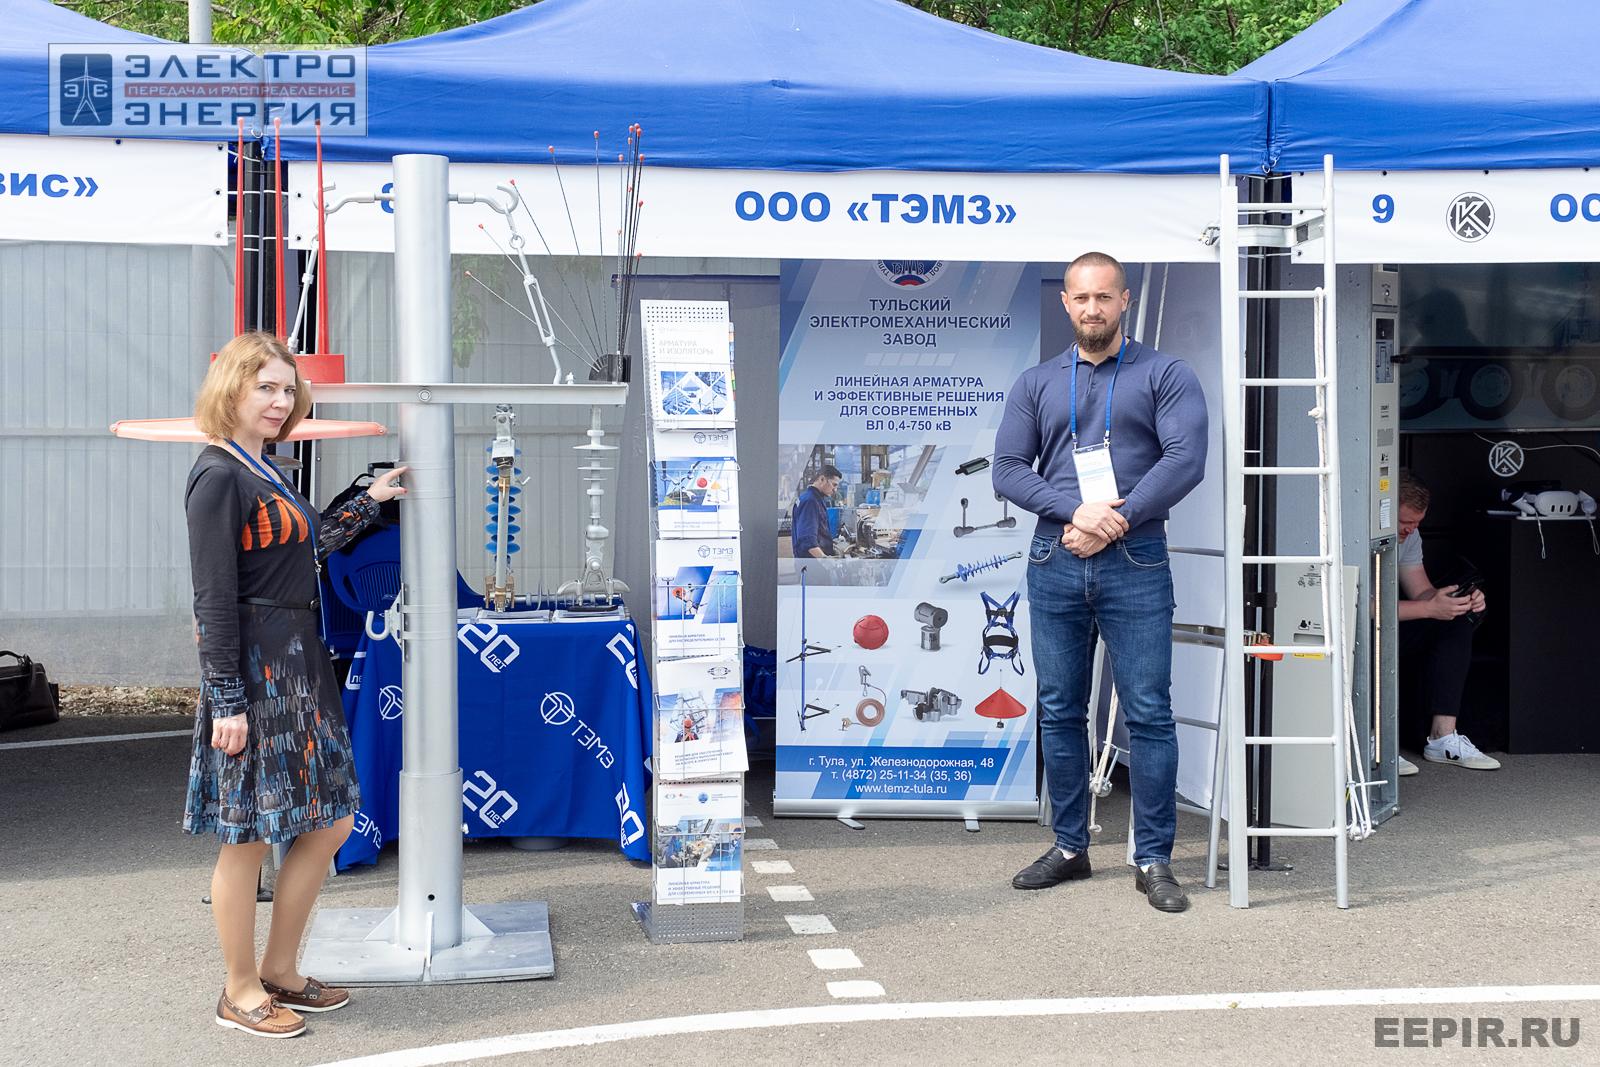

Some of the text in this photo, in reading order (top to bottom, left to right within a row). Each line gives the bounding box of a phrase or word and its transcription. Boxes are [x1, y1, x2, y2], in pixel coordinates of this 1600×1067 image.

[735, 191, 1017, 225] ООО «ТЭМЗ»
[1372, 193, 1395, 223] 9
[869, 297, 951, 312] ТУЛЬСКИЙ
[810, 314, 1011, 329] ЭЛЕКТРОМЕХАНИЧЕСКИЙ
[883, 333, 937, 347] ЗАВОД
[835, 374, 984, 388] ЛИНЕЙНАЯ АРМАТУРА
[814, 391, 1004, 402] И ЭФФЕКТИВНЫЕ РЕШЕНИЯ
[839, 405, 978, 418] ДЛЯ СОВРЕМЕННЫХ
[866, 420, 952, 433] ВЛ 0,4-750 кВ
[808, 756, 994, 769] г. Тула, ул. Железнодорожная, 48
[841, 769, 877, 782] (4872)
[879, 770, 927, 780] 25-11-34
[930, 769, 951, 782] (35,
[953, 770, 972, 782] 36)
[855, 784, 947, 794] www.temz-tula.ru
[352, 810, 382, 849] ЭМЗ
